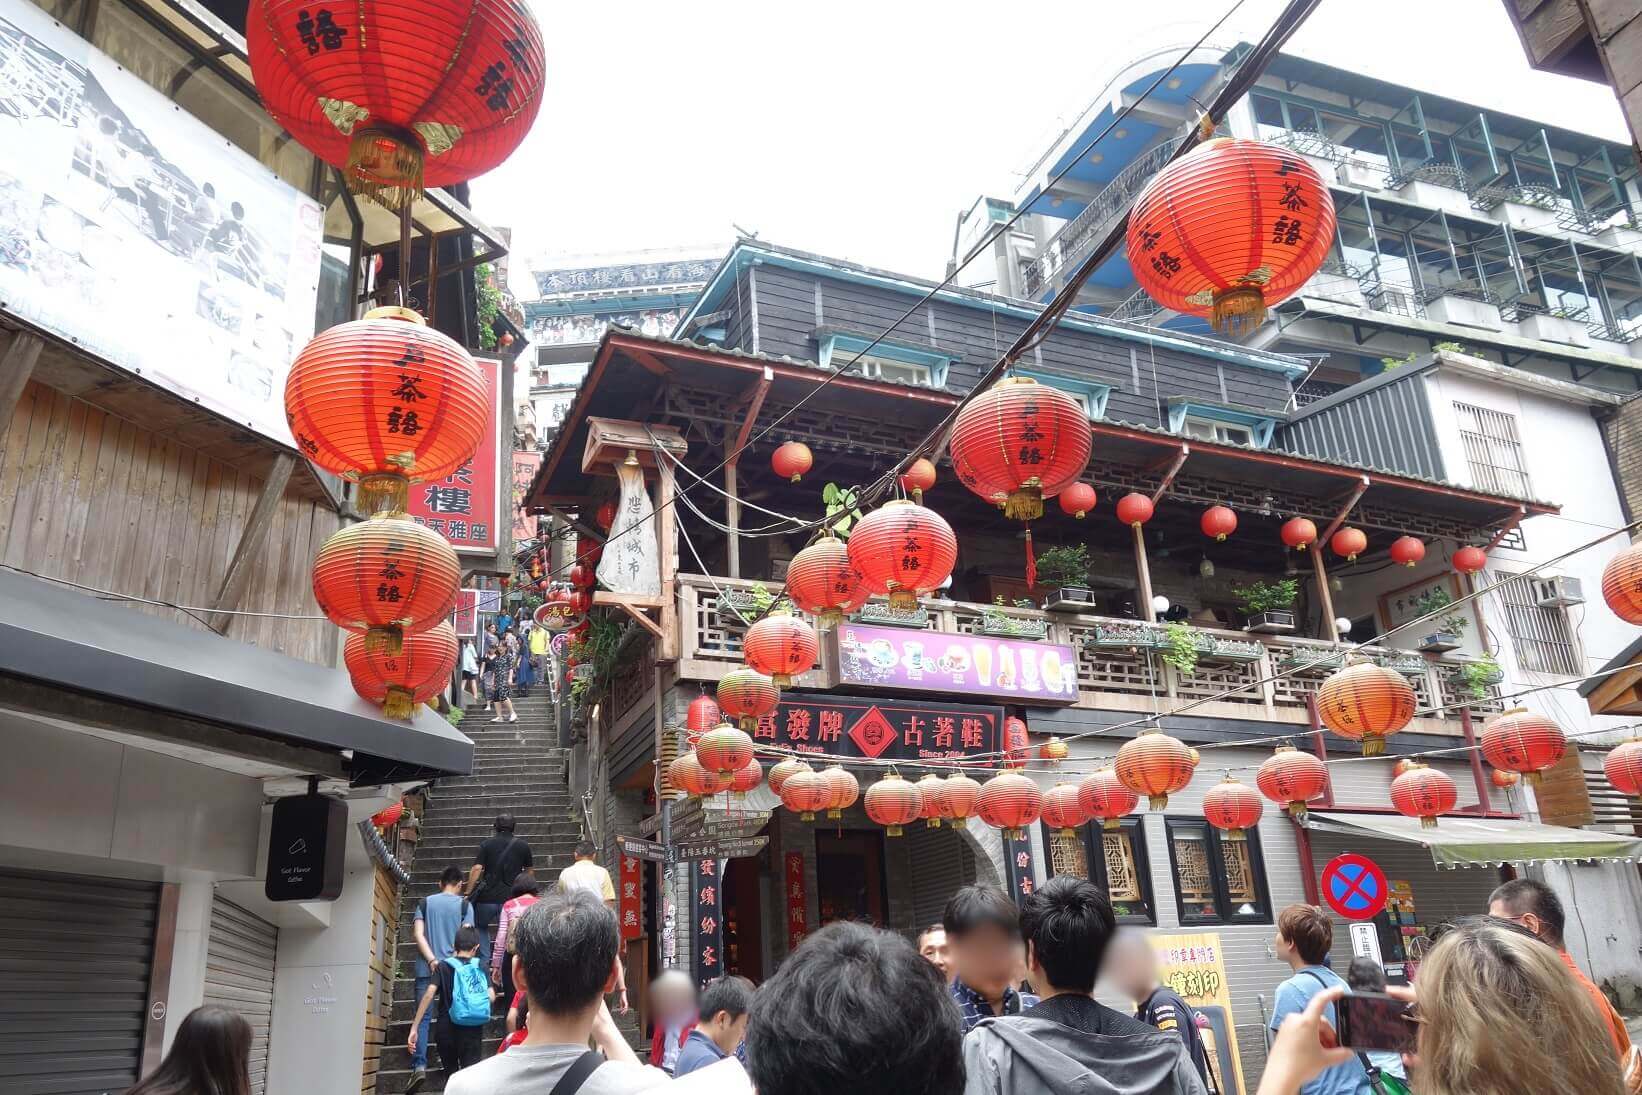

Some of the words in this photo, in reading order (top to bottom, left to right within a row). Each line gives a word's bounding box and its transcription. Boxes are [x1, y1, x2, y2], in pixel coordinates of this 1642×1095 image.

[754, 708, 845, 742] 富發牌
[902, 715, 984, 749] 古著鞋
